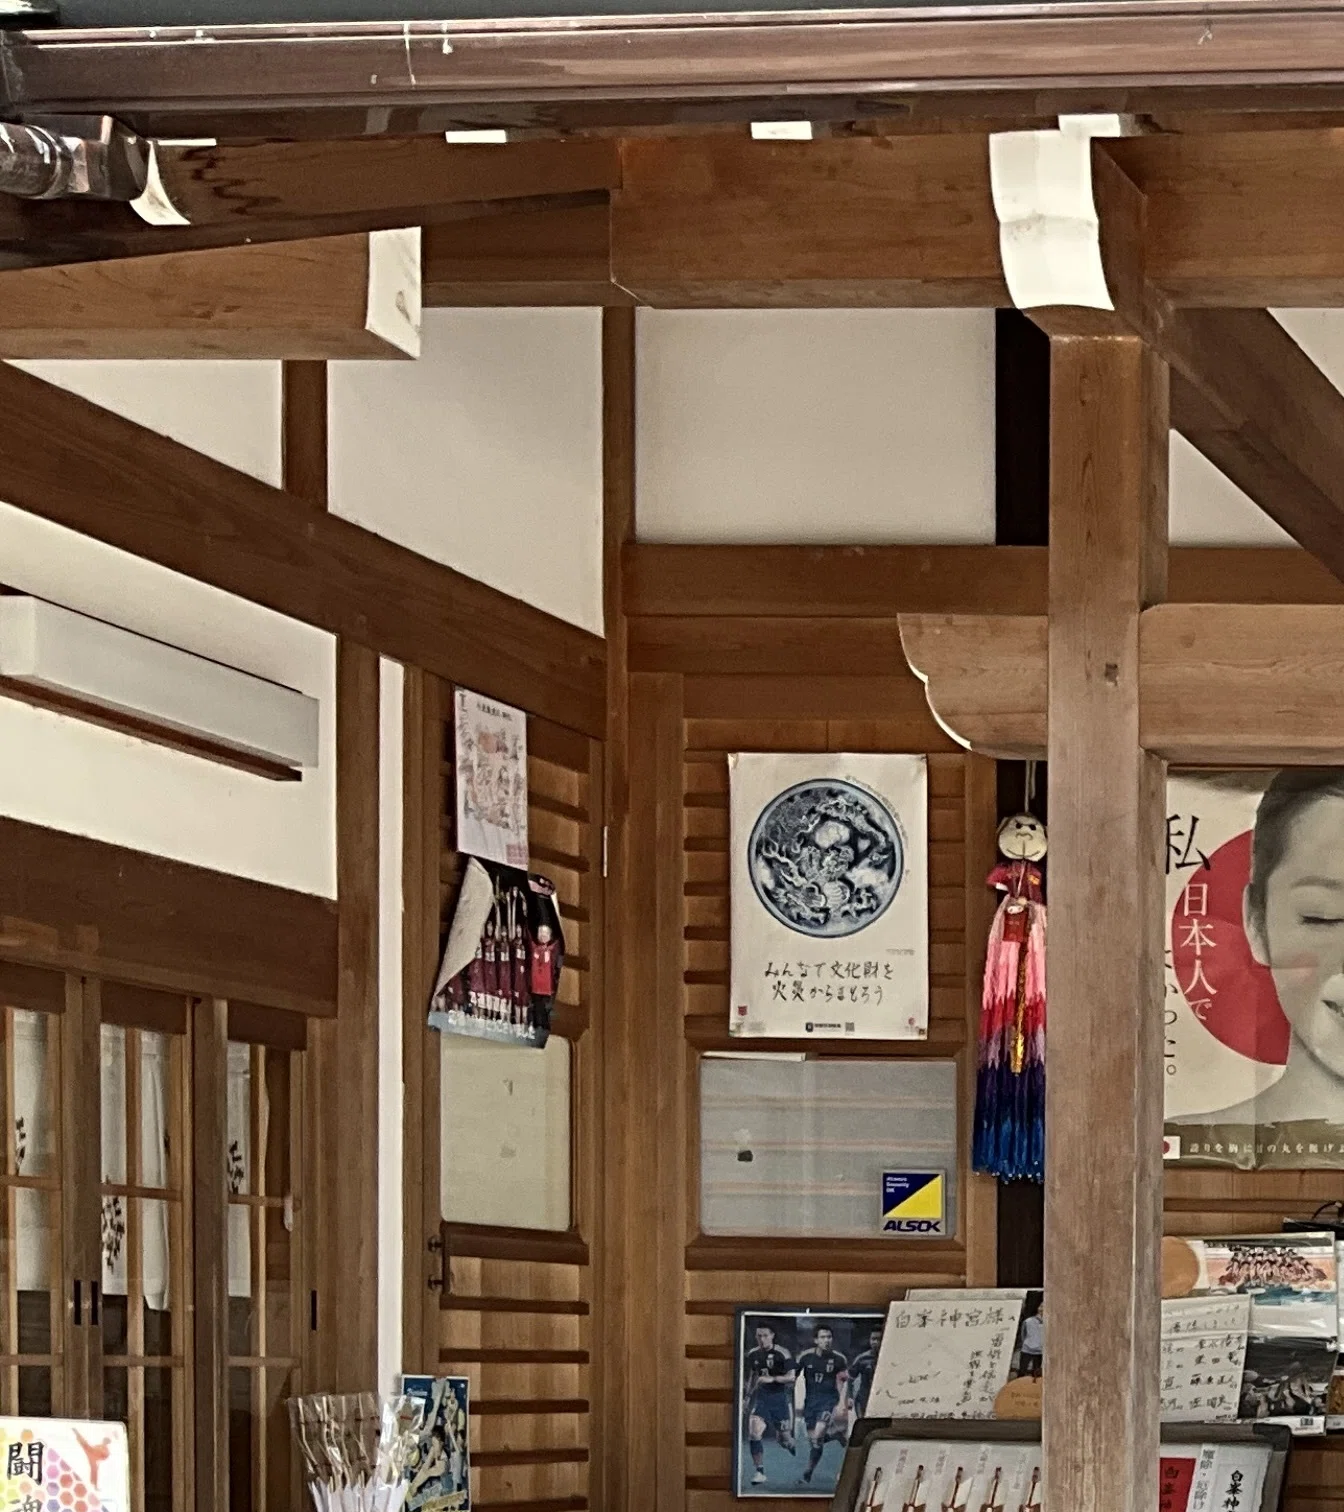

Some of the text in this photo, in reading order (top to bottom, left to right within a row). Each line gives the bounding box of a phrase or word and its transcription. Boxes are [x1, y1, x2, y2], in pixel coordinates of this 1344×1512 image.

[1178, 882, 1218, 1022] 日本人で
[883, 1220, 941, 1232] ALSOK
